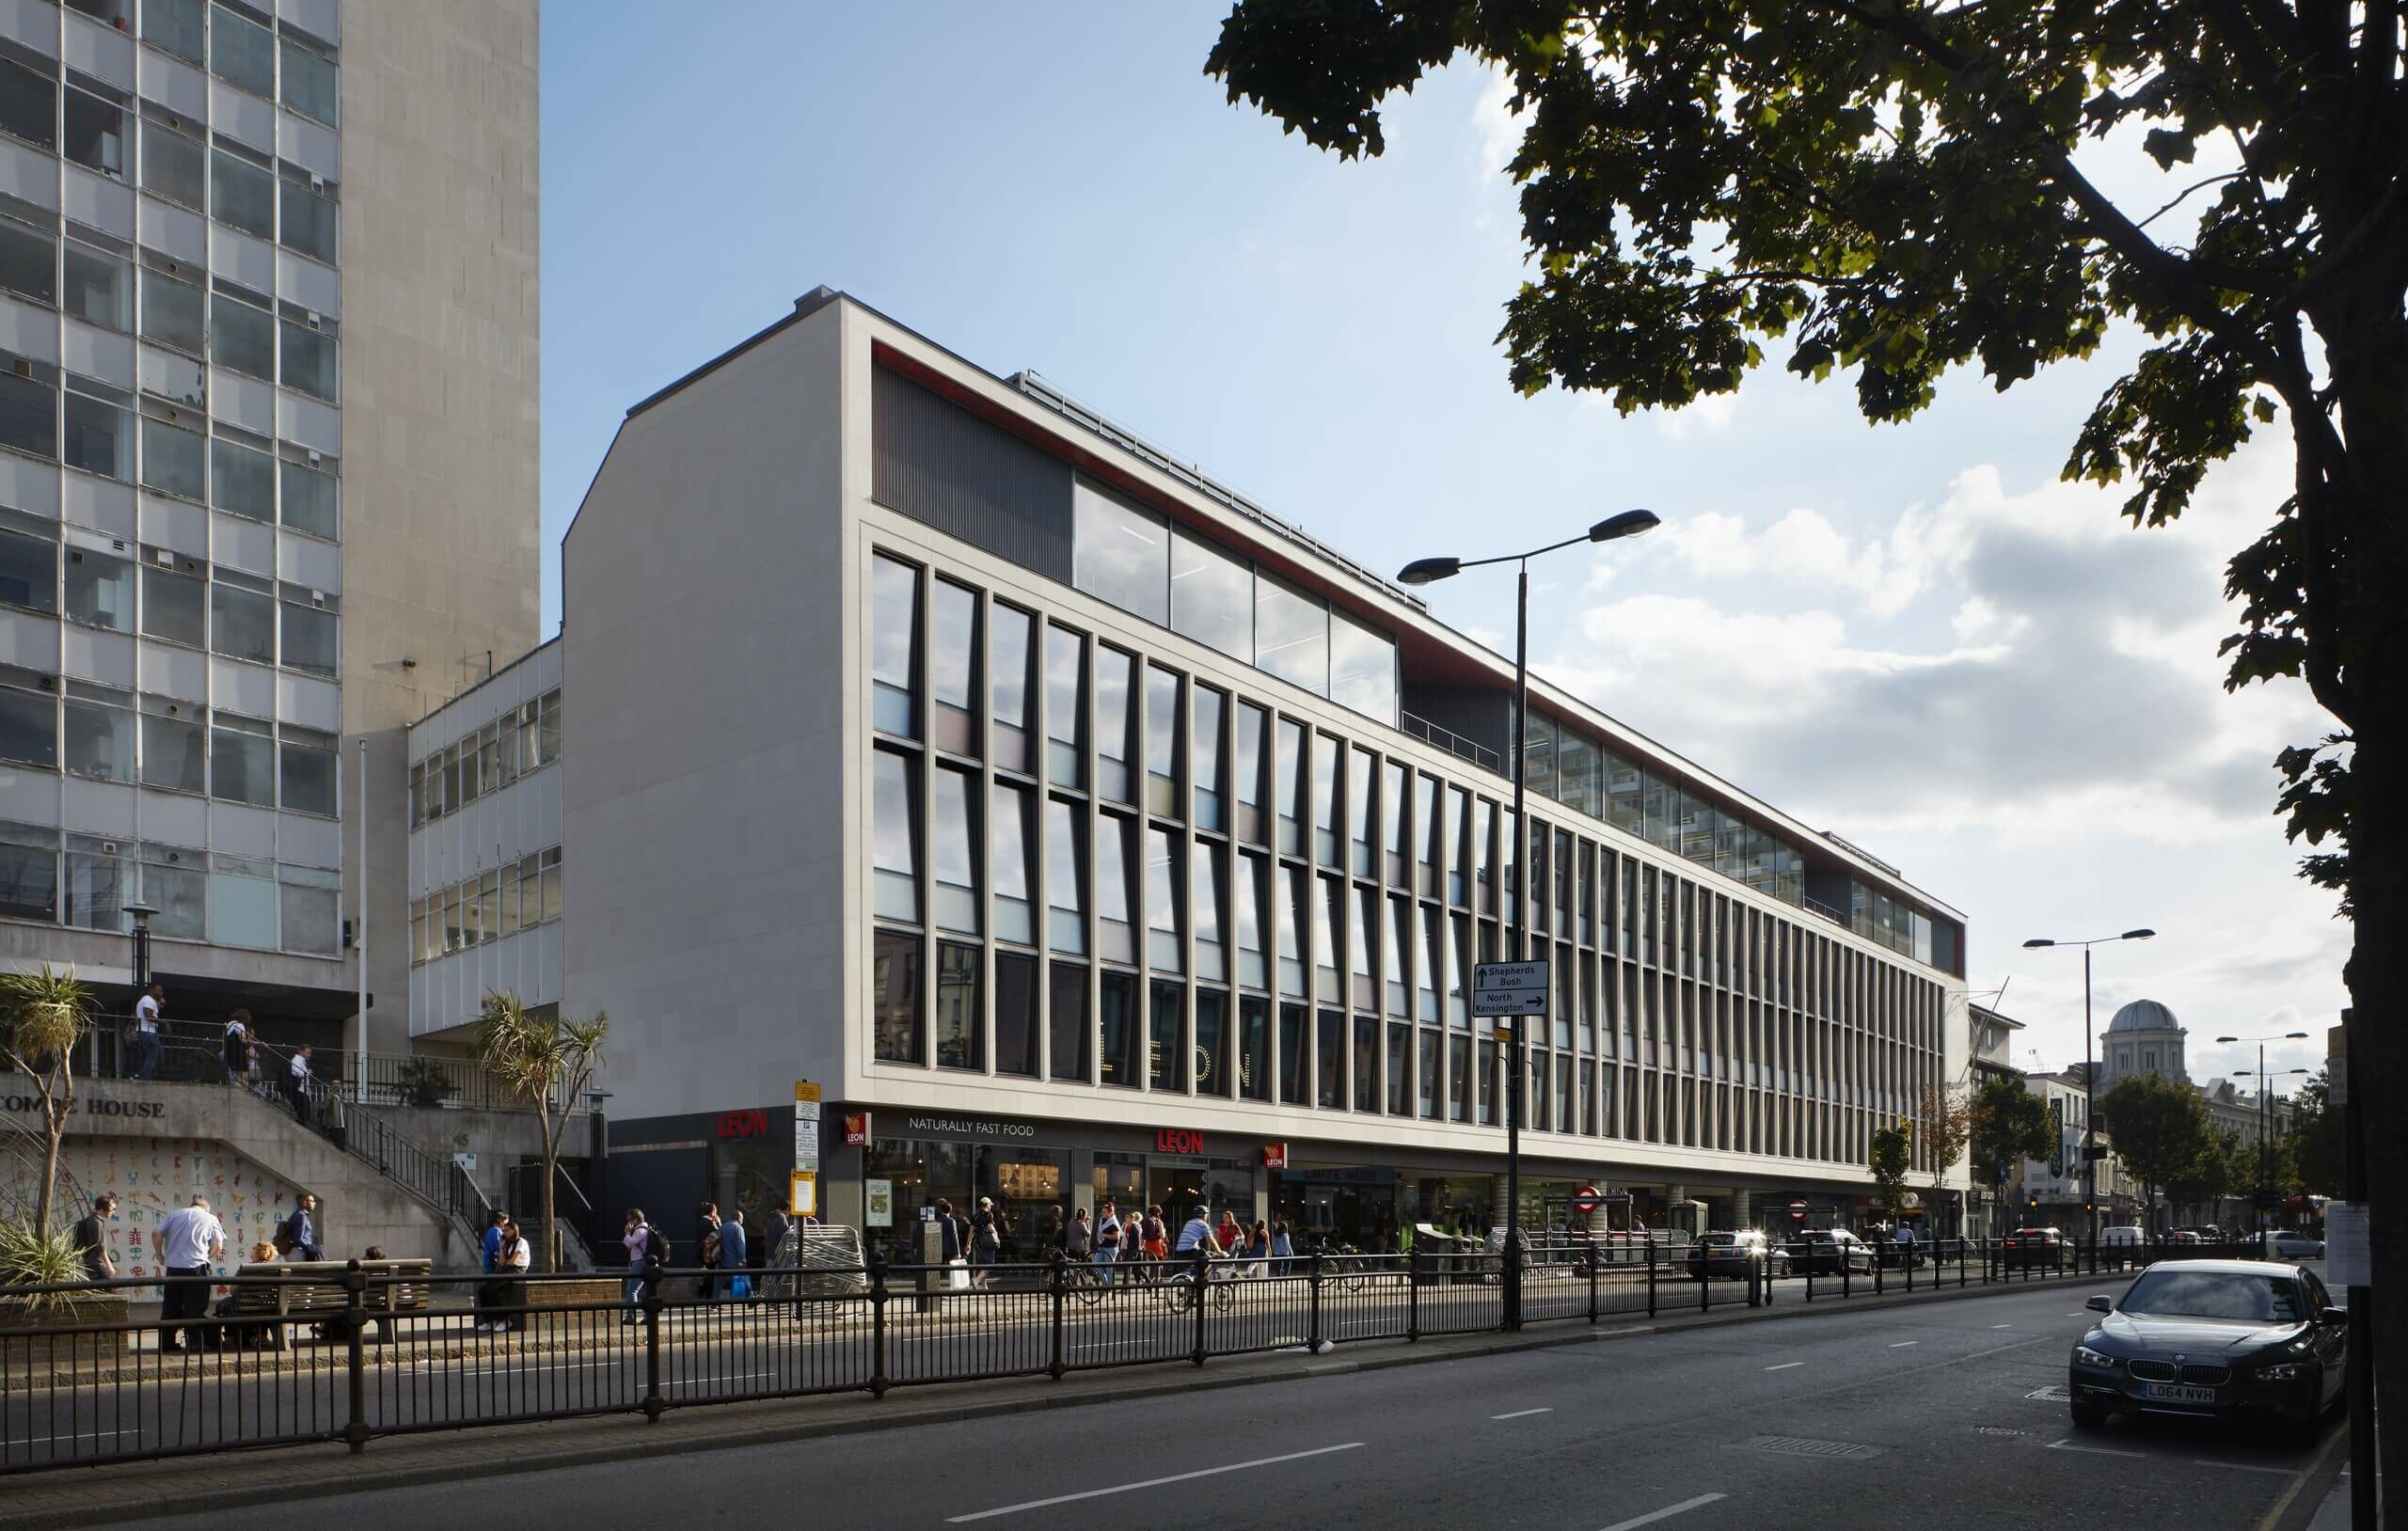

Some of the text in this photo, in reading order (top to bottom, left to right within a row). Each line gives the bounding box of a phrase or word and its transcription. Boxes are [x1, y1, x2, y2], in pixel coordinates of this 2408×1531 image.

[1489, 966, 1535, 976] Shepherds
[1499, 977, 1522, 986] Bush
[1486, 992, 1513, 1002] North
[1475, 1003, 1524, 1013] Kensington
[87, 1098, 166, 1118] HOUSE
[717, 1109, 768, 1139] LEON
[909, 1117, 1035, 1136] NATURALLY FAST FOOD
[848, 1132, 864, 1142] LEON
[1158, 1129, 1204, 1155] LEON
[1267, 1158, 1282, 1166] LEON
[2185, 1388, 2212, 1401] NVH
